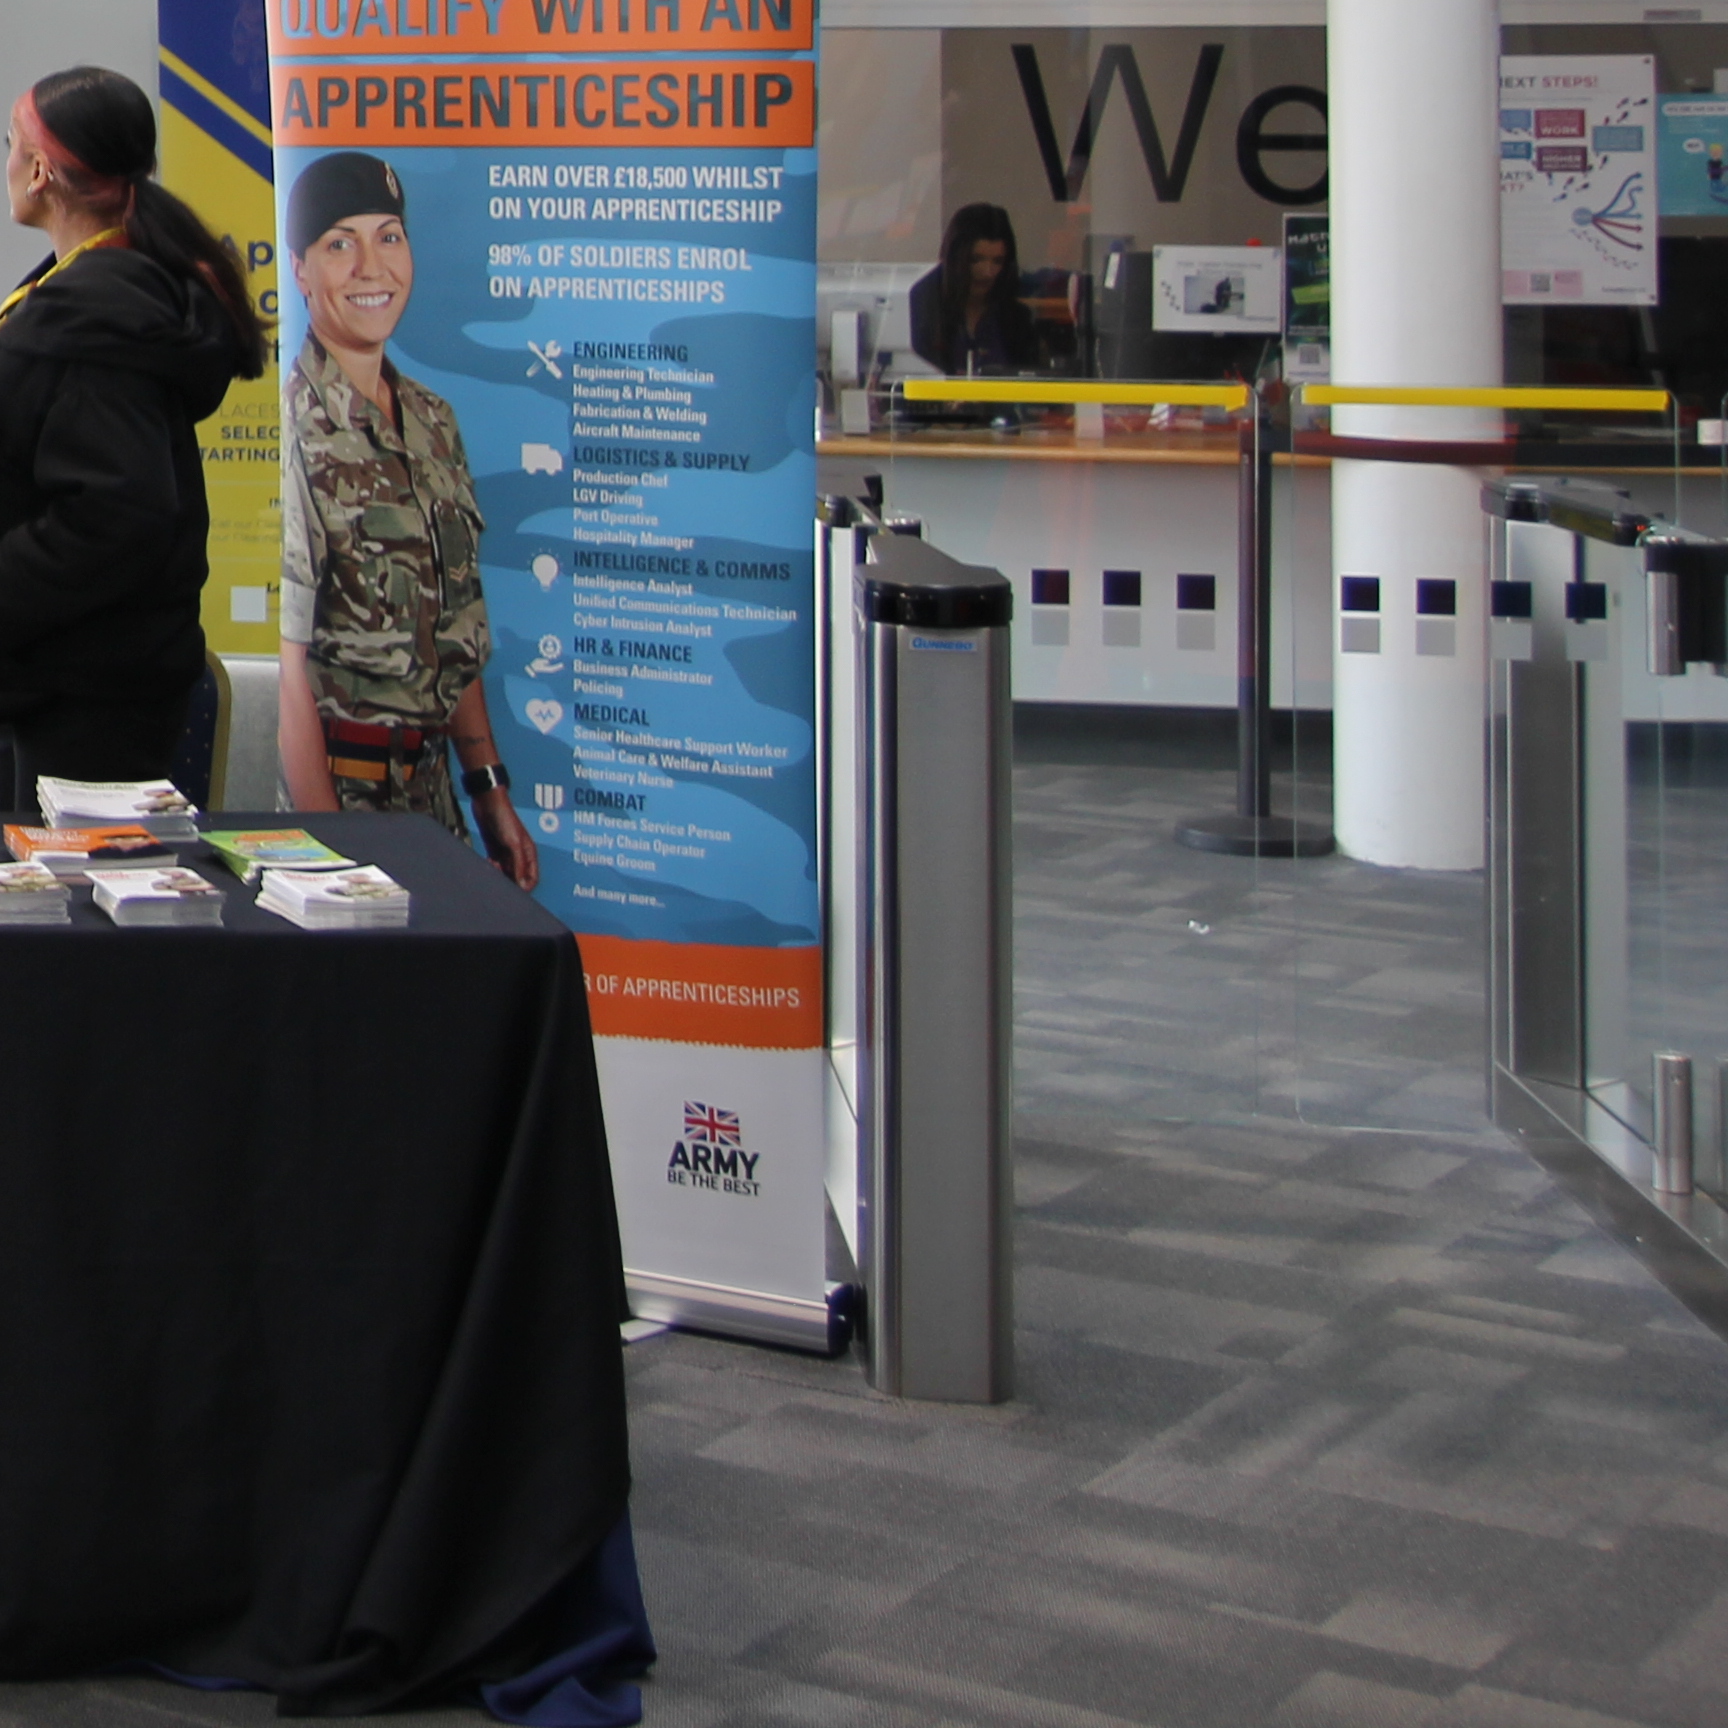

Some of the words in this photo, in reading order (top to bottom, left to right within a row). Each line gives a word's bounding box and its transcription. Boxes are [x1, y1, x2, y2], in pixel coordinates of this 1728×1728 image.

[1500, 76, 1536, 89] EXT
[1542, 75, 1598, 88] STEPS!
[281, 72, 793, 130] APPRENTICESHIP
[1010, 43, 1328, 207] We
[489, 165, 548, 188] EARN
[554, 166, 609, 189] OVER
[614, 166, 688, 191] £18,500
[692, 167, 784, 190] WHILST
[489, 197, 521, 219] ON
[527, 197, 586, 220] YOUR
[591, 198, 783, 222] APPRENTICESHIP
[489, 244, 532, 266] 98%
[538, 245, 565, 267] OF
[570, 246, 672, 269] SOLDIERS
[677, 248, 753, 271] ENROL
[489, 276, 521, 299] ON
[527, 277, 726, 304] APPRENTICESHIPS
[573, 341, 689, 362] ENGINEERING
[573, 365, 644, 384] Engineering
[648, 369, 714, 383] Technician
[221, 426, 280, 440] SELEC
[573, 423, 619, 437] Aircraft
[621, 425, 701, 442] Maintenance
[200, 446, 280, 461] TARTING
[573, 446, 660, 467] LOGISTICS
[665, 450, 677, 466] &
[683, 451, 749, 471] SUPPLY
[573, 551, 692, 575] INTELLIGENCE
[696, 559, 709, 576] &
[715, 561, 792, 581] COMMS
[574, 637, 596, 654] HR
[601, 639, 613, 655] &
[619, 641, 692, 663] FINANCE
[573, 703, 649, 726] MEDICAL
[574, 789, 646, 810] COMBAT
[573, 883, 595, 898] And
[597, 889, 626, 905] many
[597, 974, 618, 995] OF
[623, 977, 800, 1008] APPRENTICESHIPS
[668, 1141, 760, 1180] ARMY
[667, 1169, 686, 1186] BE
[692, 1172, 719, 1191] THE
[723, 1177, 761, 1197] BEST
